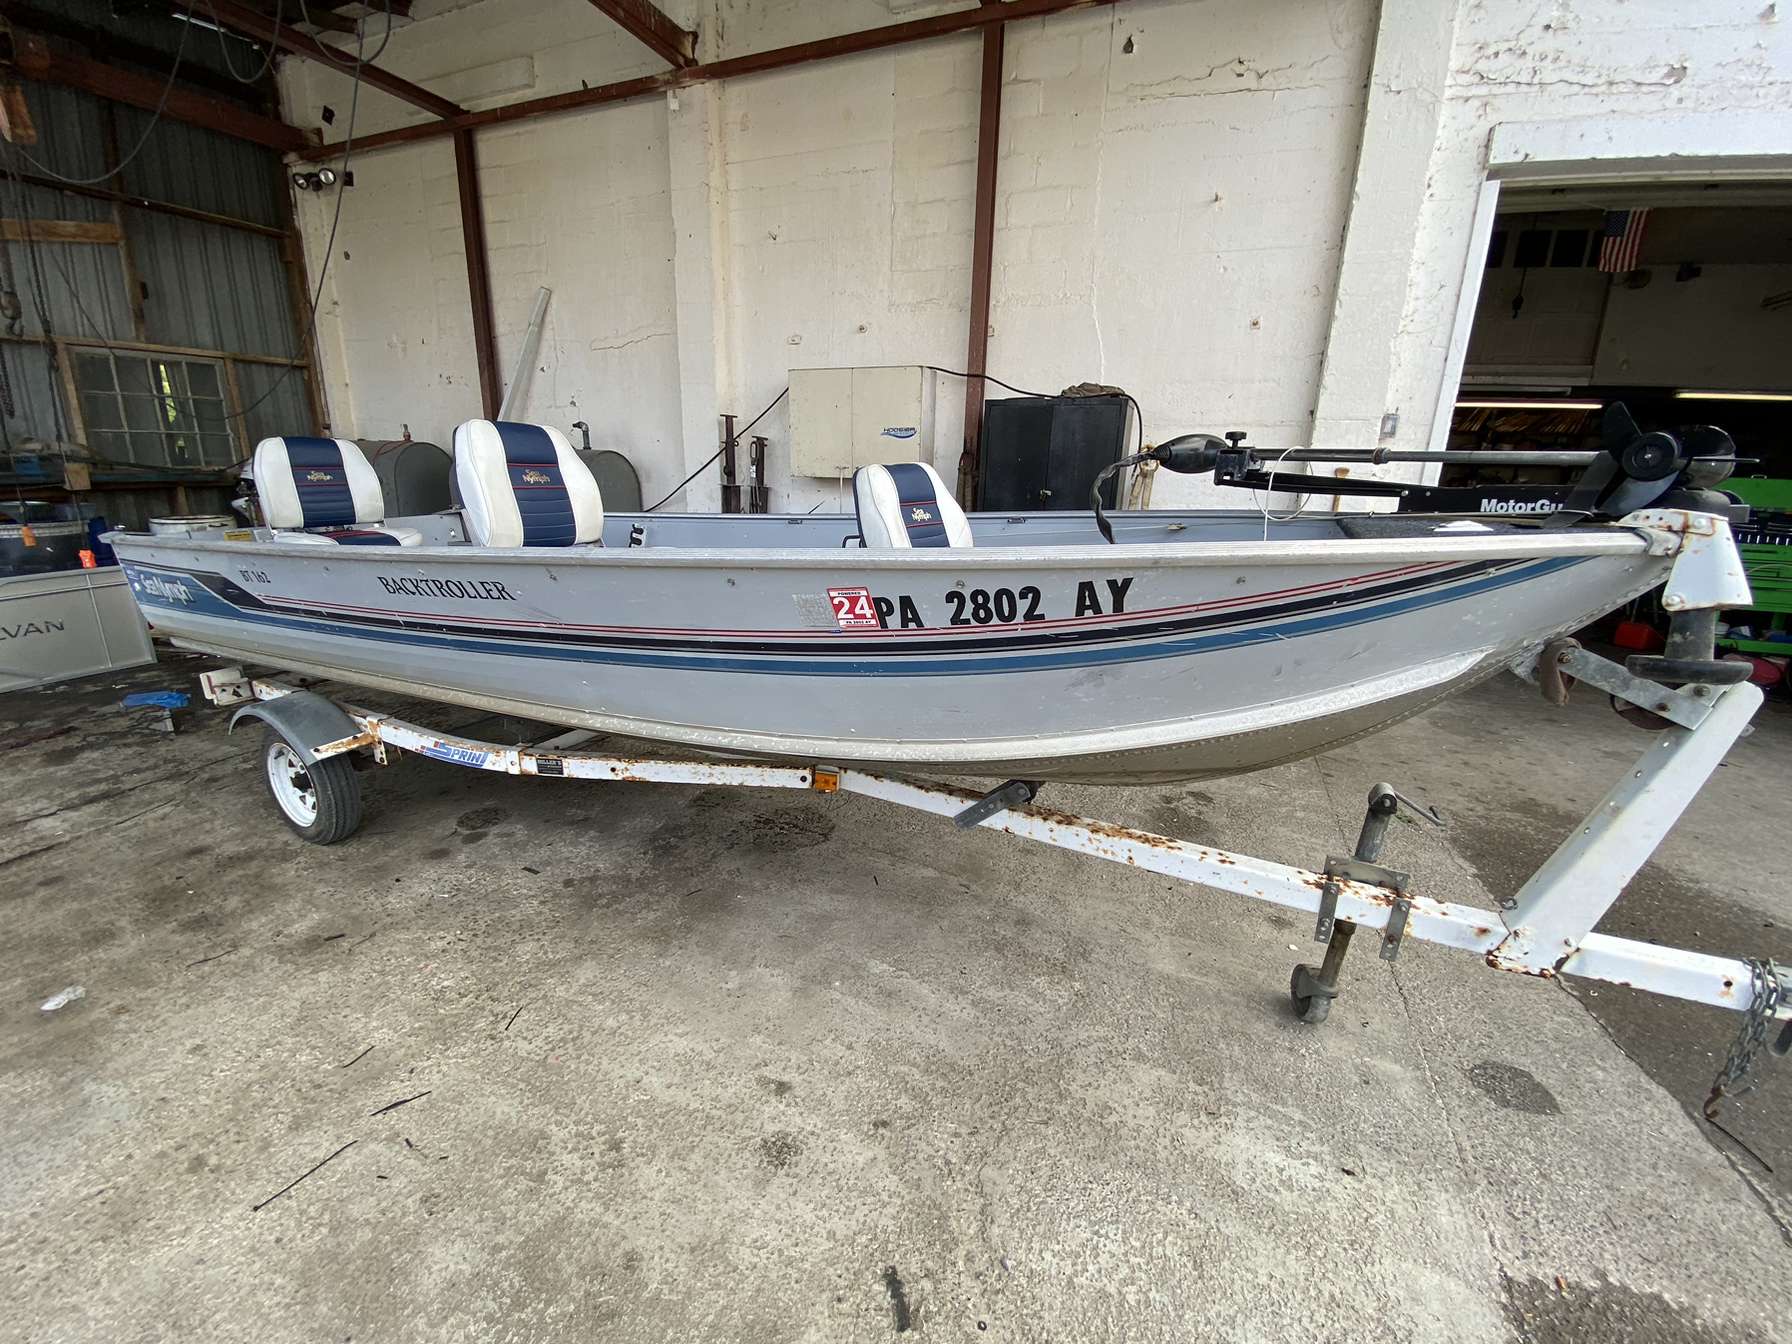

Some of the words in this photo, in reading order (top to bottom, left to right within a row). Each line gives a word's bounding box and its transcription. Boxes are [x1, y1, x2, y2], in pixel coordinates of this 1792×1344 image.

[377, 576, 517, 601] BACKTROLLER
[832, 596, 873, 619] 24
[872, 596, 925, 629] PA
[945, 586, 1046, 626] 2802
[1075, 577, 1134, 617] AY
[0, 620, 65, 640] VAN
